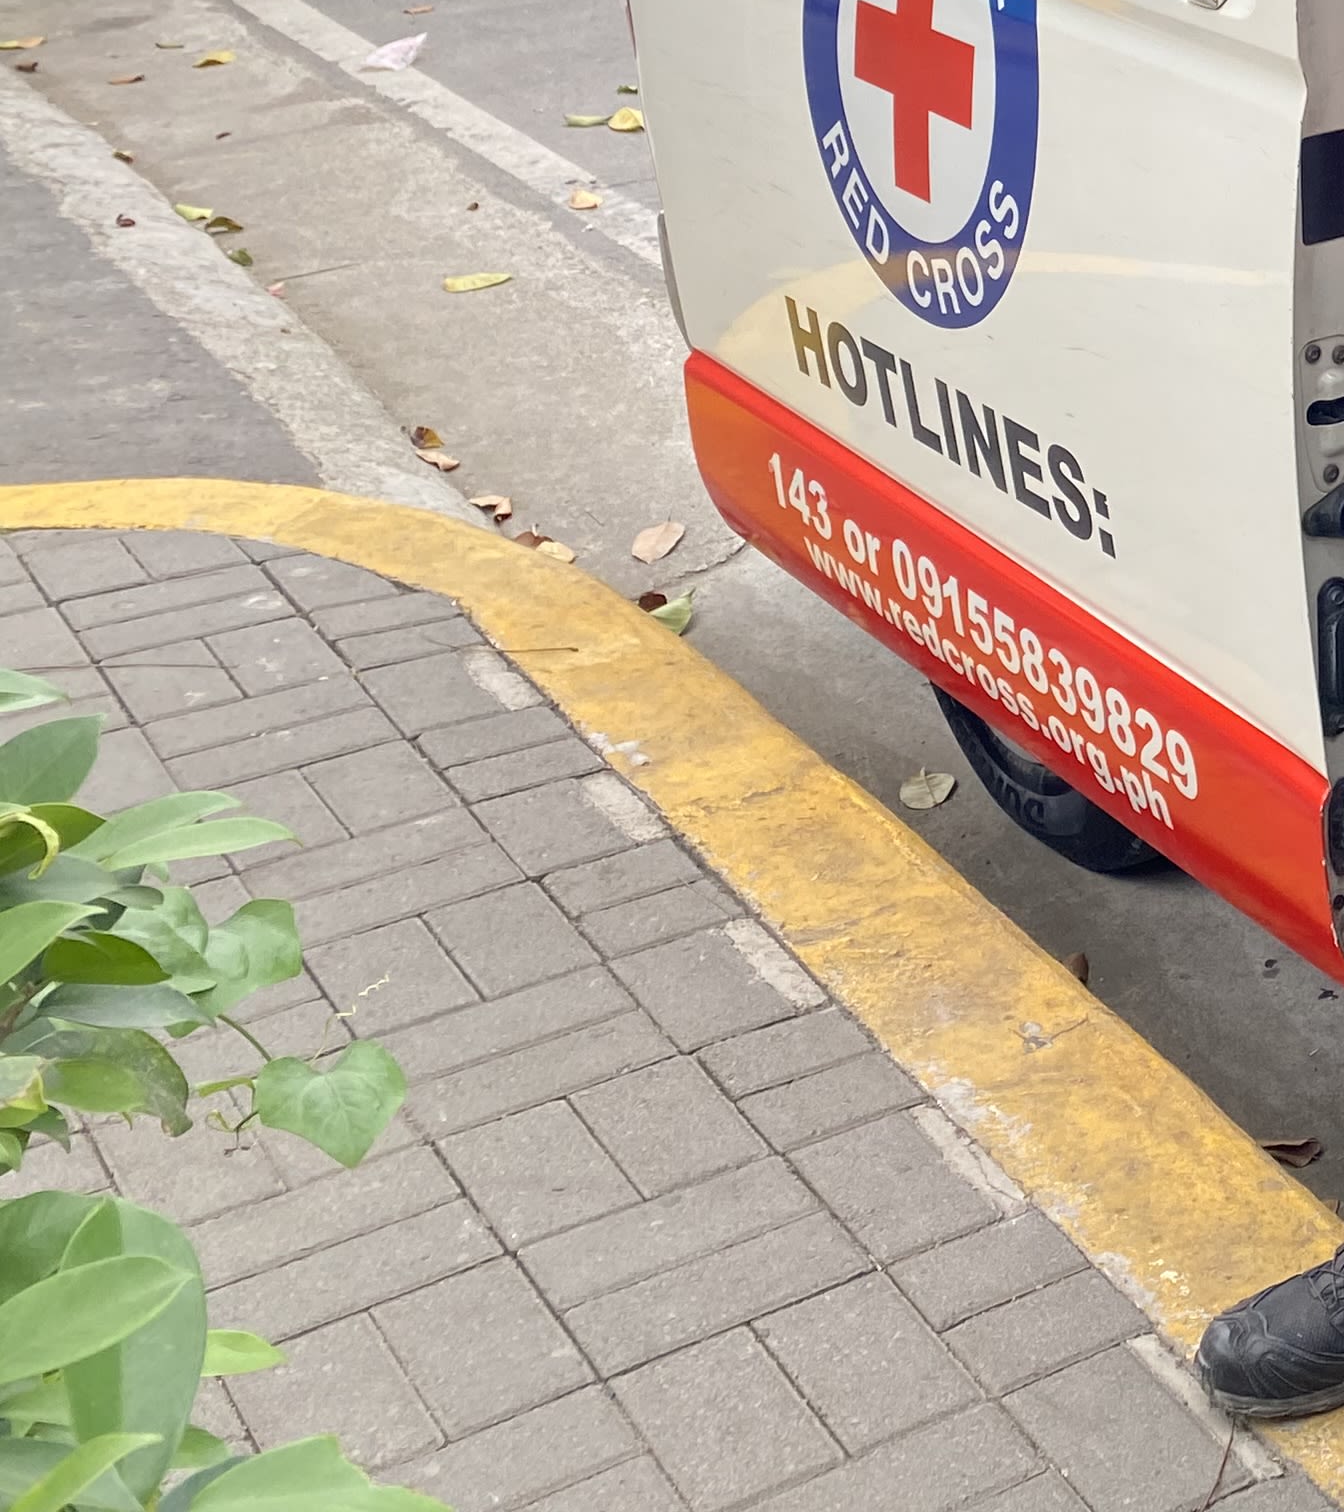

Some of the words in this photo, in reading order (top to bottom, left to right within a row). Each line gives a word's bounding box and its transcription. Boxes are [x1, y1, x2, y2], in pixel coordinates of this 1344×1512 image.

[822, 120, 890, 265] RED
[906, 180, 1019, 315] CROSS
[785, 295, 1116, 559] HOTLINES:
[768, 452, 832, 541] 143
[843, 518, 881, 576] or
[892, 538, 1198, 801] 09155839829
[803, 537, 1174, 830] www.redcross.org.ph
